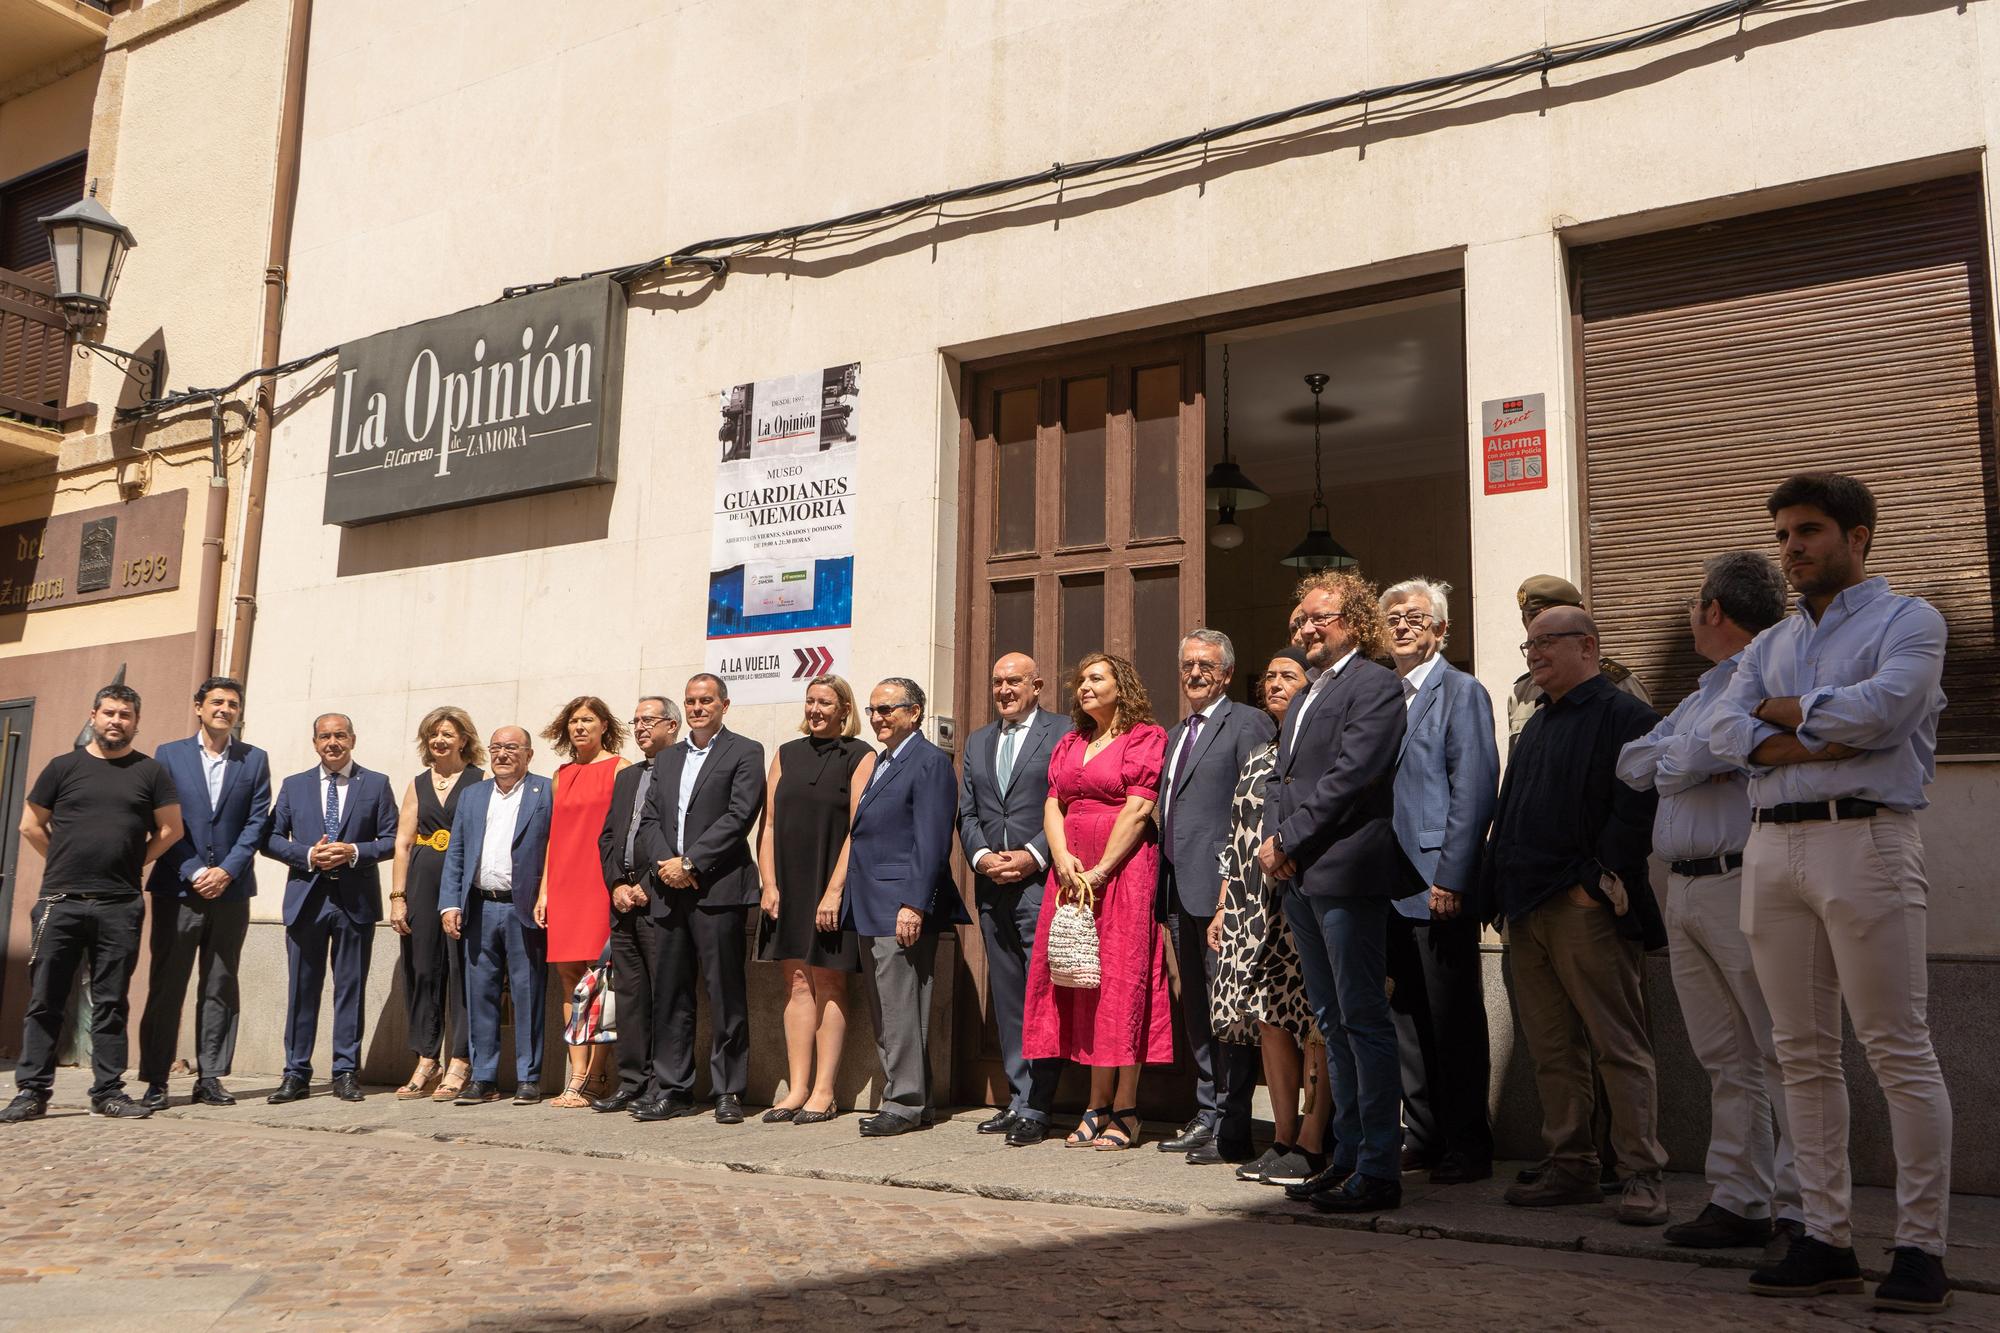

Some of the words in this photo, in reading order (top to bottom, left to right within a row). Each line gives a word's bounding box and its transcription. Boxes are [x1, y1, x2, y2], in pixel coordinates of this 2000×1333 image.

[335, 369, 388, 457] La
[405, 325, 592, 477] Opinión
[758, 418, 770, 436] La
[774, 412, 815, 438] Opinión
[1493, 410, 1536, 432] Direct
[384, 450, 395, 468] El
[394, 448, 434, 466] Correo
[451, 435, 461, 449] de
[466, 425, 527, 457] ZAMORA
[1487, 436, 1541, 452] Alarma
[767, 465, 803, 480] MUSEO
[723, 476, 848, 511] GUARDIANES
[729, 512, 739, 521] DE
[740, 511, 750, 520] LA
[749, 499, 846, 527] MEMORIA
[17, 528, 47, 560] del
[781, 527, 806, 538] SÁBADOS
[811, 523, 842, 533] DOMINGOS
[0, 577, 64, 605] Zamora
[720, 658, 727, 673] A
[730, 657, 742, 672] LA
[745, 654, 780, 671] VUELTA
